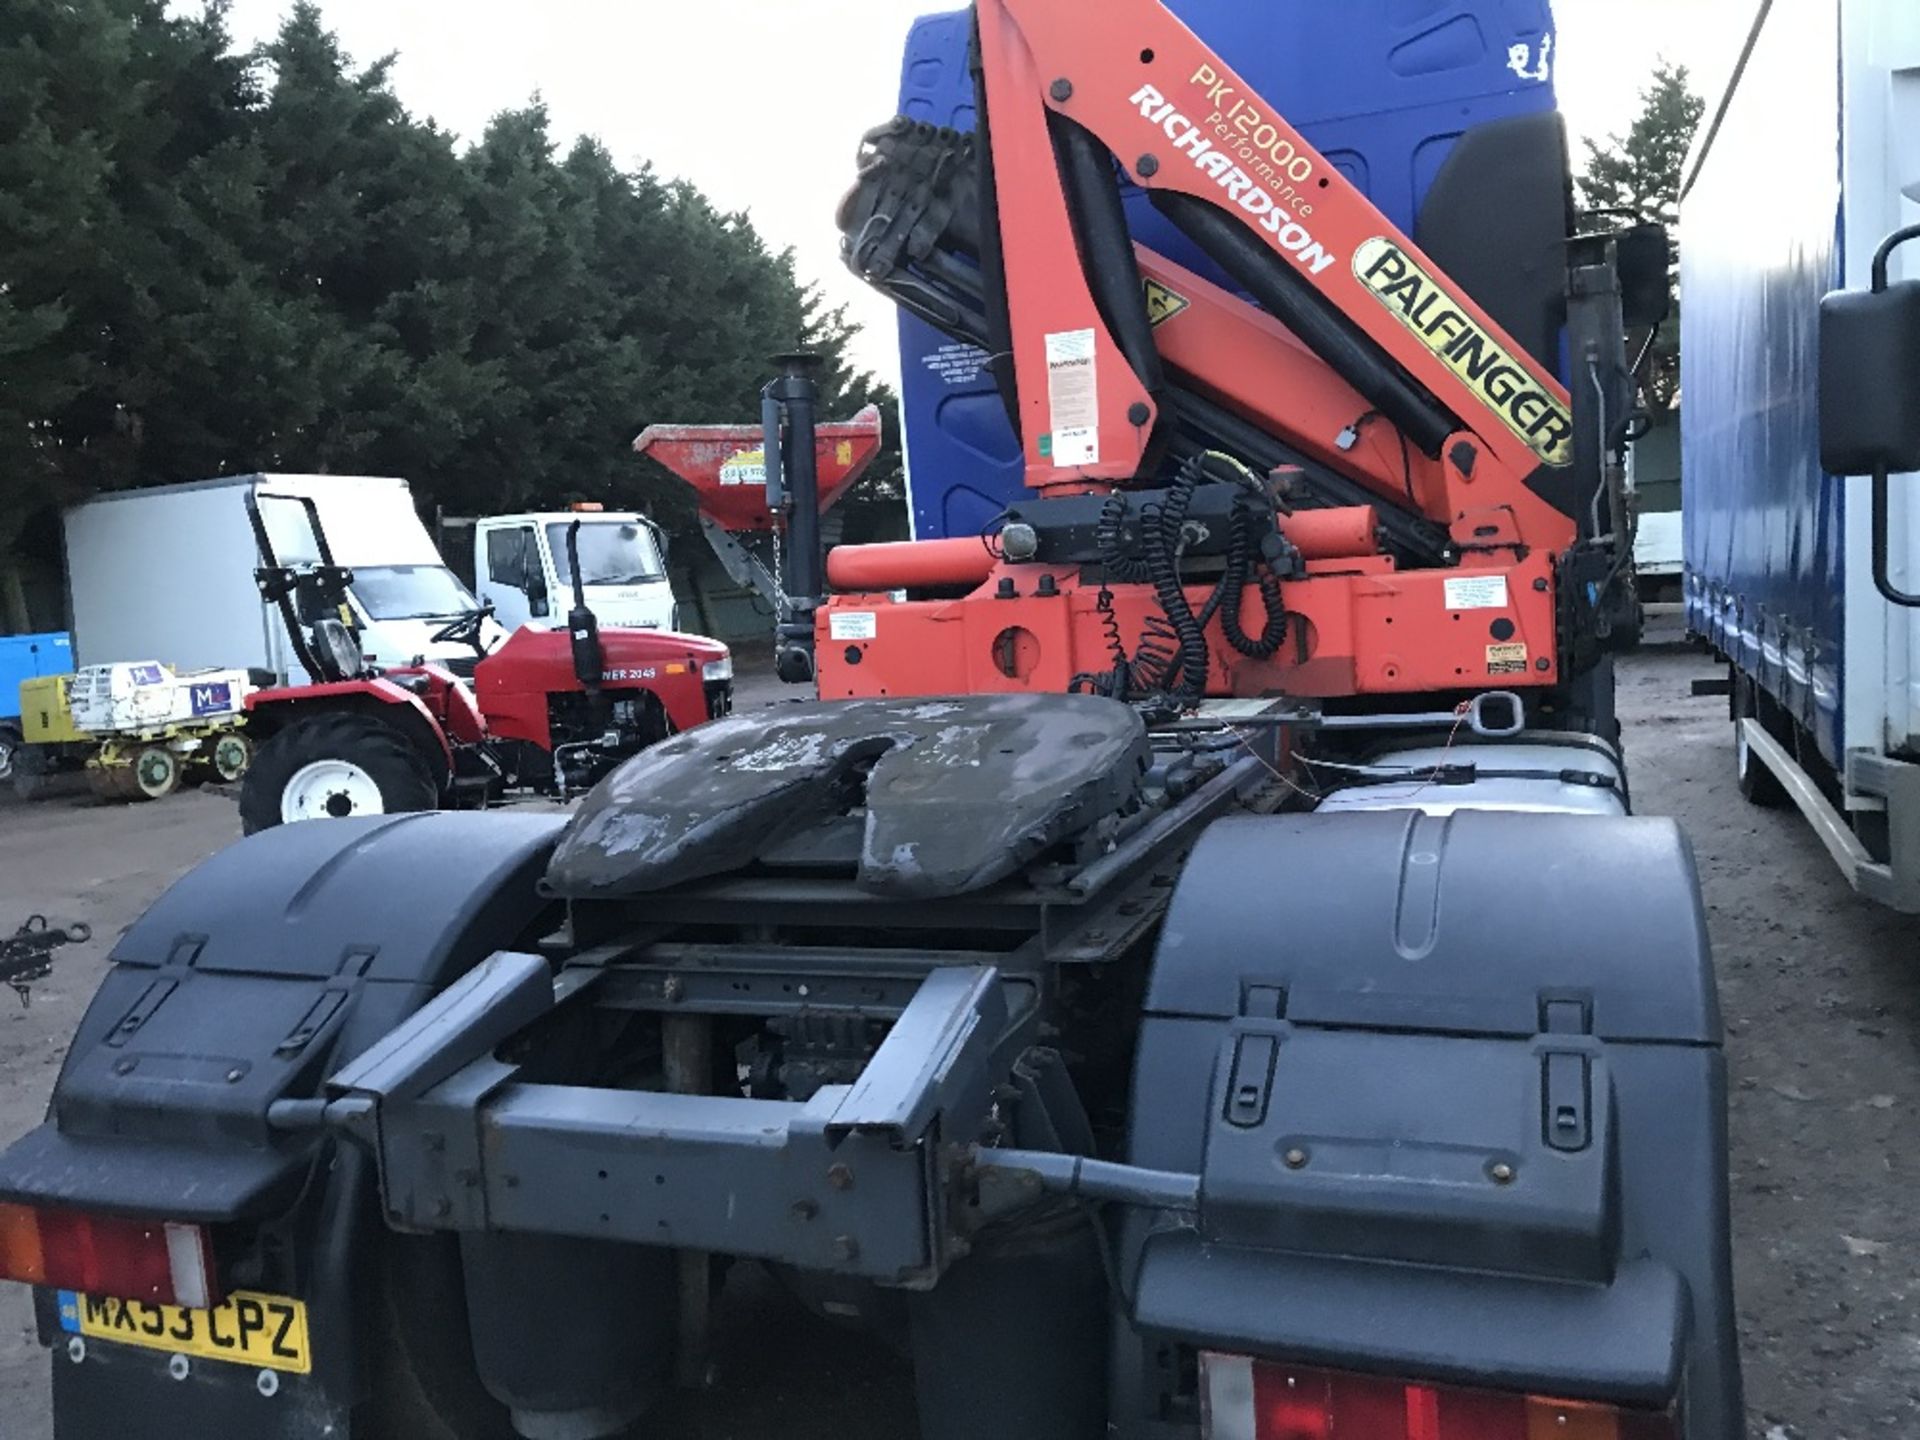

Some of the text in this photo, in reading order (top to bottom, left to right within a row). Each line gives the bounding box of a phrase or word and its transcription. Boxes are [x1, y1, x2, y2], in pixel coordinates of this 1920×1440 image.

[1128, 84, 1336, 275] RICHARDSON
[1205, 111, 1313, 218] Performance
[1364, 248, 1572, 454] PALFINGER
[208, 1298, 299, 1358] CPZ
